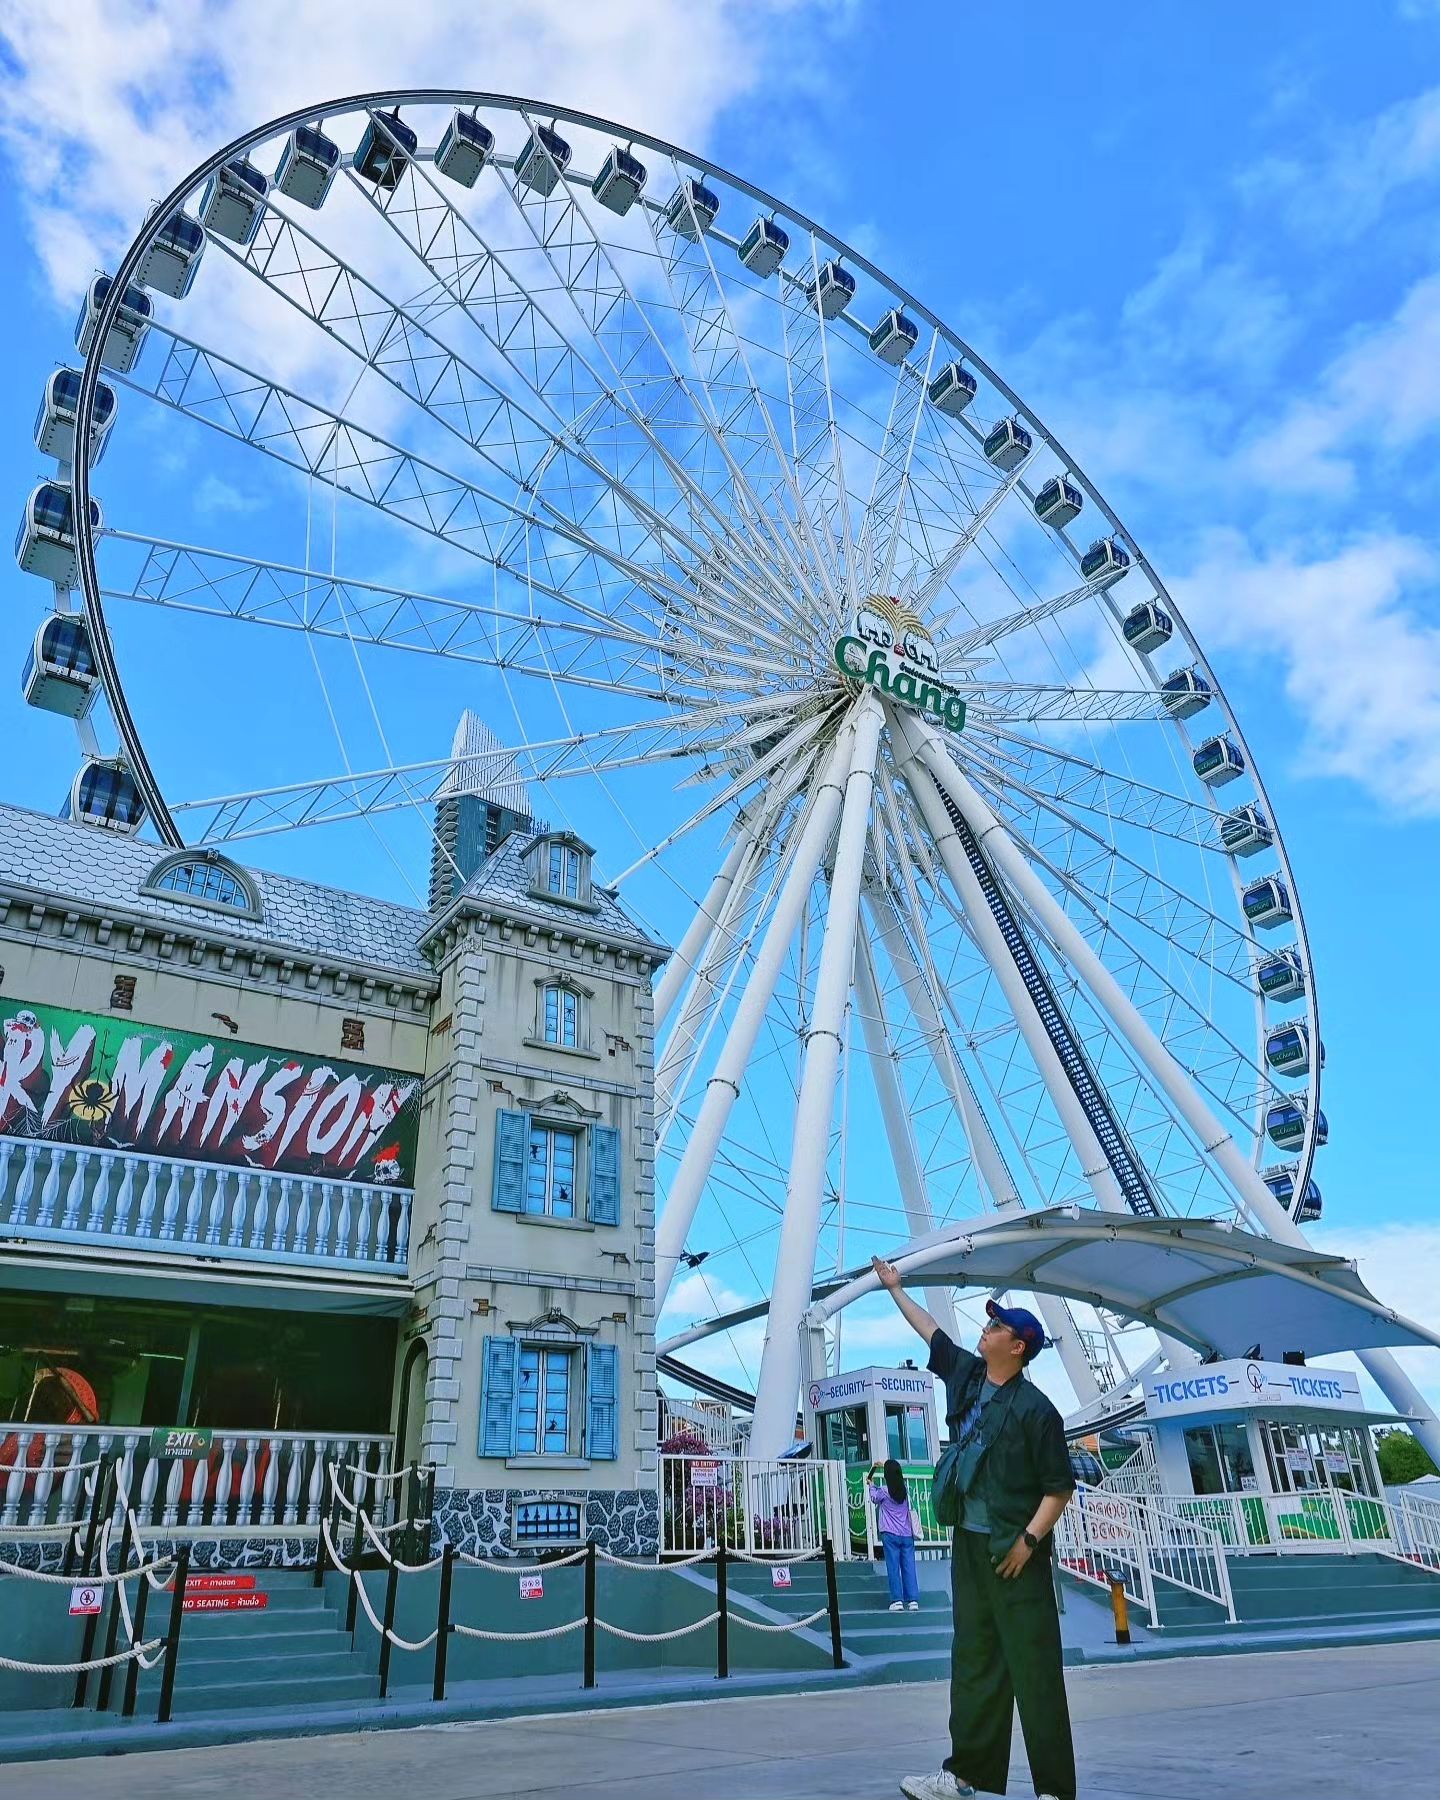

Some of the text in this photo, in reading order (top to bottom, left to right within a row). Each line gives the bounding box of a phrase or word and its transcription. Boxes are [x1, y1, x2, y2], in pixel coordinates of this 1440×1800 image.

[834, 636, 967, 732] Chang
[0, 1018, 413, 1167] RY MANSION
[830, 1380, 866, 1399] SECURITY
[881, 1378, 926, 1392] SECURITY
[1154, 1375, 1229, 1403] TICKETS
[1289, 1377, 1342, 1399] TICKETS
[165, 1431, 198, 1447] EXIT
[182, 1600, 194, 1609] NO
[196, 1599, 229, 1608] SEATING
